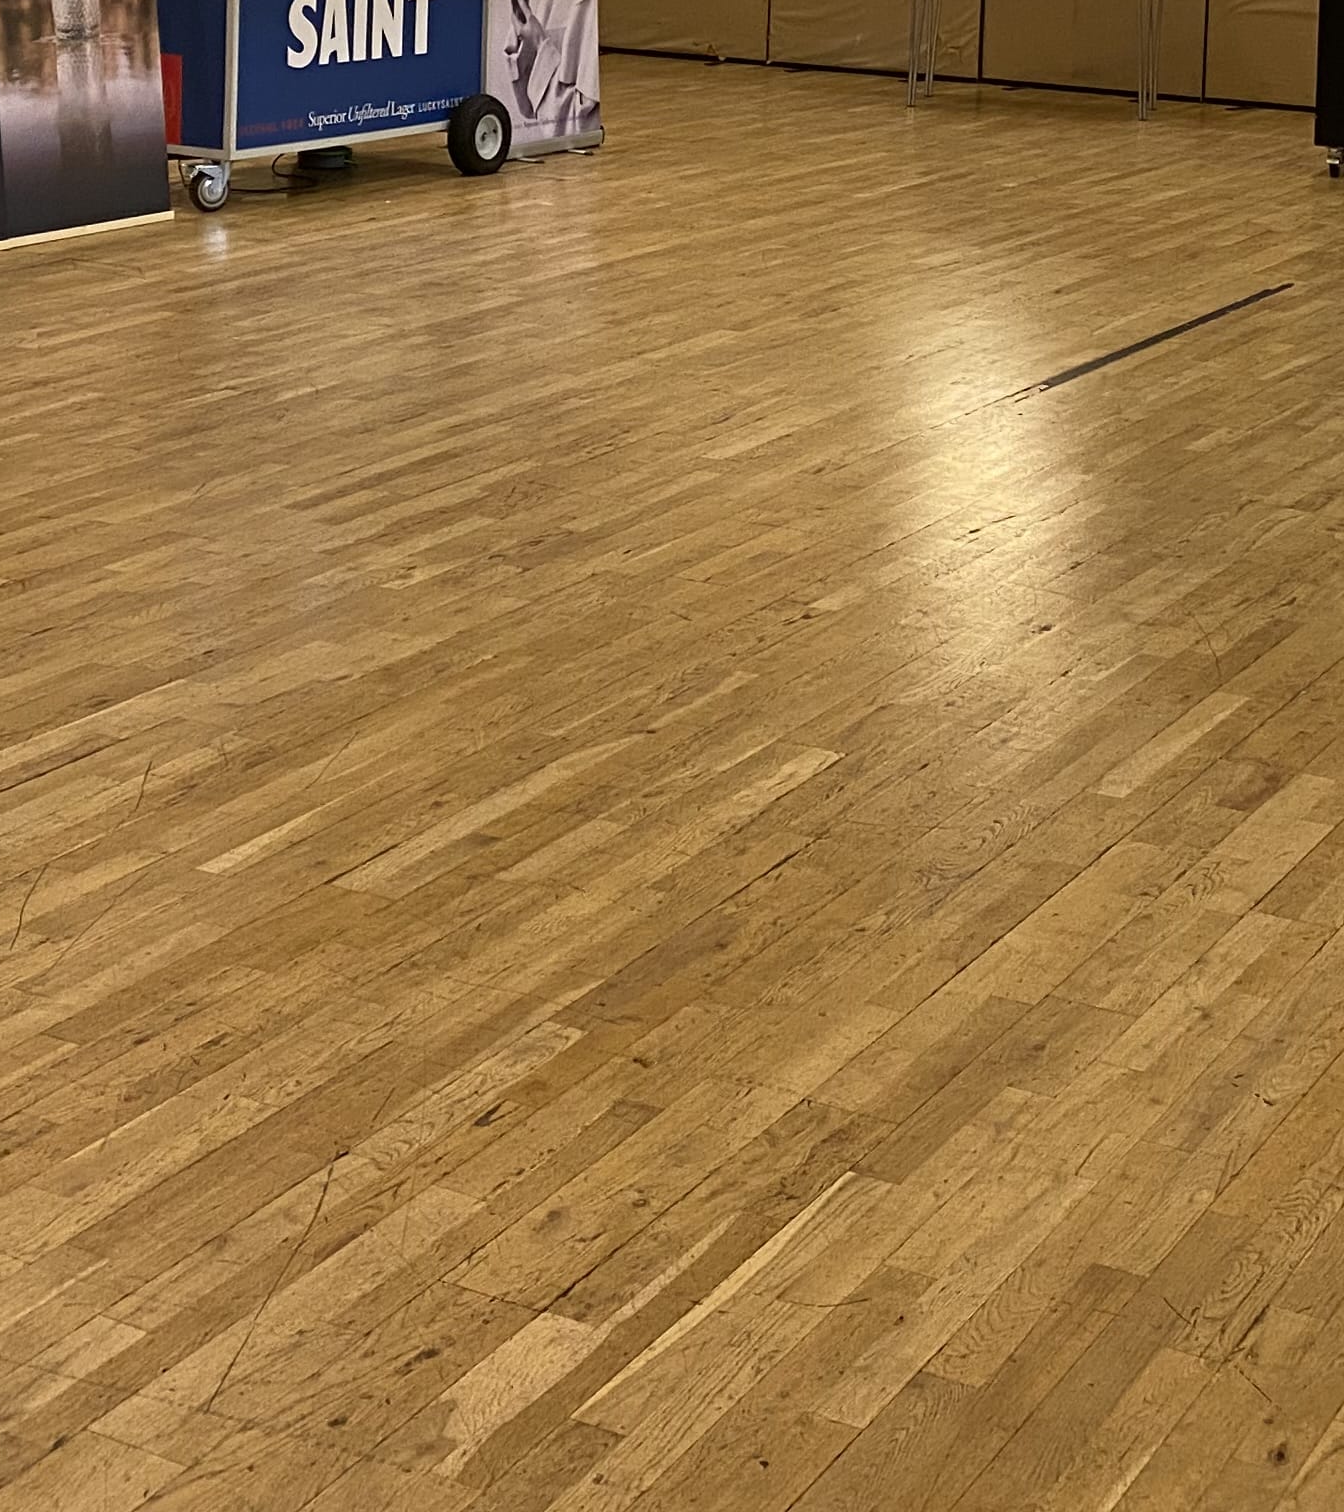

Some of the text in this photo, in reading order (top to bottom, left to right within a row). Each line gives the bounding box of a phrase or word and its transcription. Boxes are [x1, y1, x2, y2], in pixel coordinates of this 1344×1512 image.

[307, 109, 347, 131] Superior
[348, 100, 391, 126] Unfiltered
[391, 101, 416, 121] Lager
